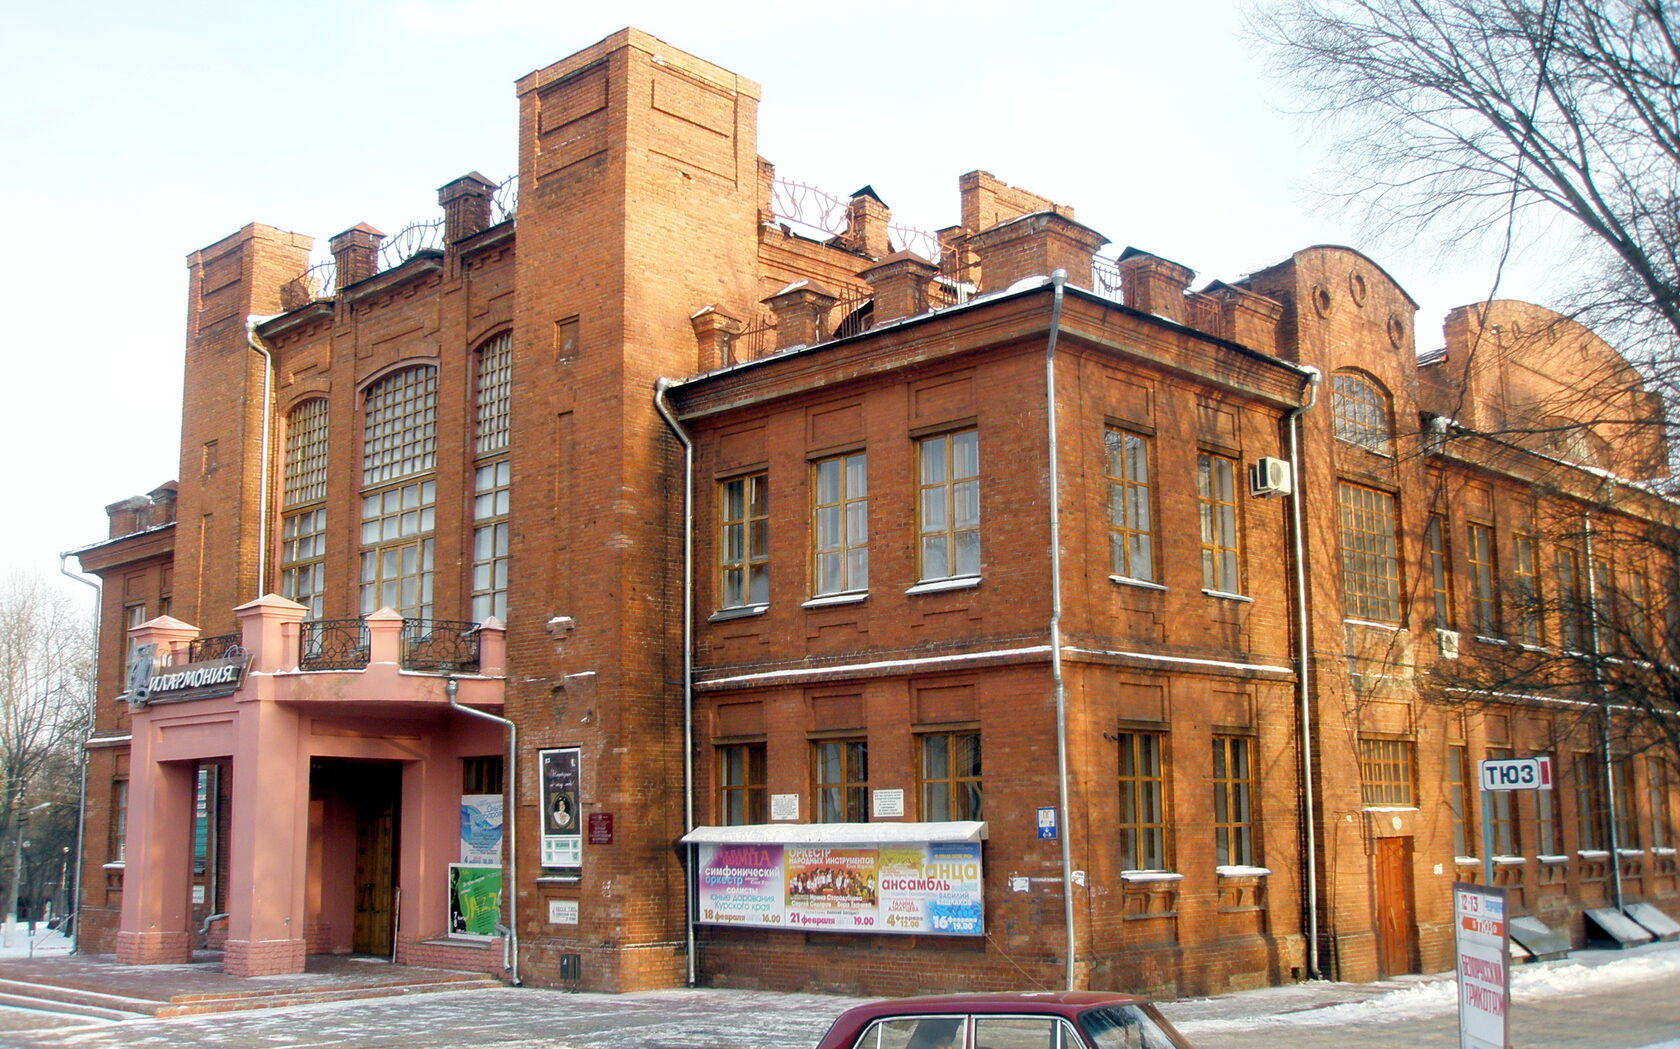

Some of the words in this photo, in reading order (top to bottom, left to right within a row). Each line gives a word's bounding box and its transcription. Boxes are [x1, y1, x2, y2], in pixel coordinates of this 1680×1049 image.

[1485, 764, 1535, 786] ТЮЗ
[788, 849, 832, 857] ОРКЕСТР
[788, 857, 824, 865] НАРОДНЫХ
[825, 857, 875, 865] ИНСТРУМЕНТОВ
[704, 865, 780, 877] симфонический
[704, 875, 743, 886] оркестр
[881, 876, 951, 891] ансамбль
[714, 901, 749, 911] Курского
[752, 903, 770, 911] края
[704, 909, 714, 920] 18
[715, 912, 746, 922] февраля
[790, 913, 800, 923] 21
[801, 915, 836, 926] февраля
[853, 916, 874, 926] 19.00
[887, 914, 896, 927] 4
[933, 915, 948, 929] 16
